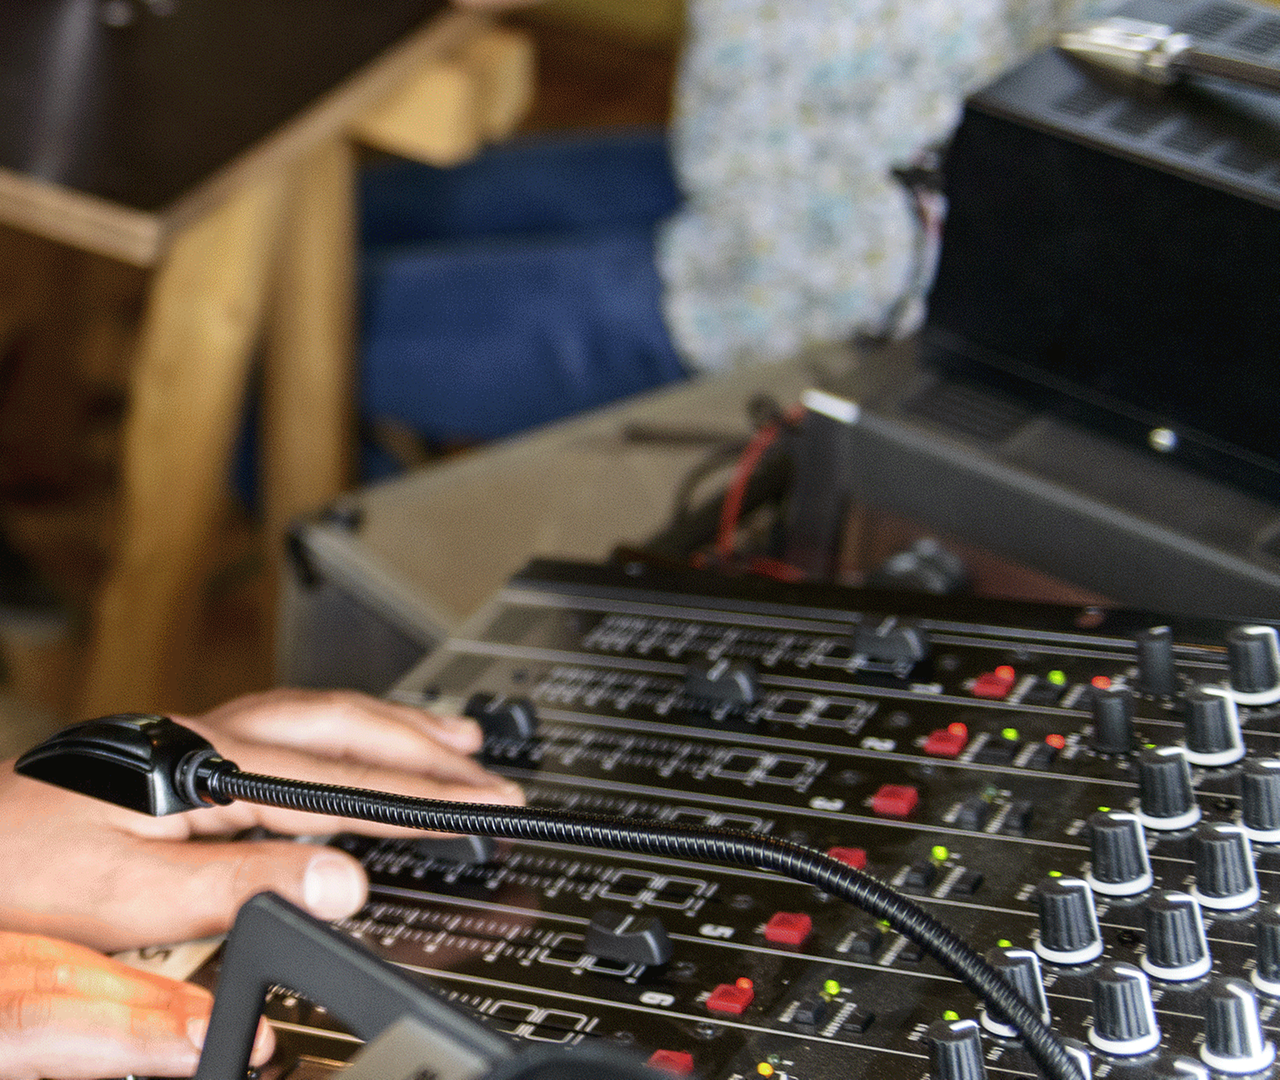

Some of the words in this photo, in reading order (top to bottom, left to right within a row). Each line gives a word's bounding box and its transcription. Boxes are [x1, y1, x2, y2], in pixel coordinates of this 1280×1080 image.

[809, 796, 845, 811] 3
[698, 923, 735, 939] 5
[639, 991, 675, 1007] 6
